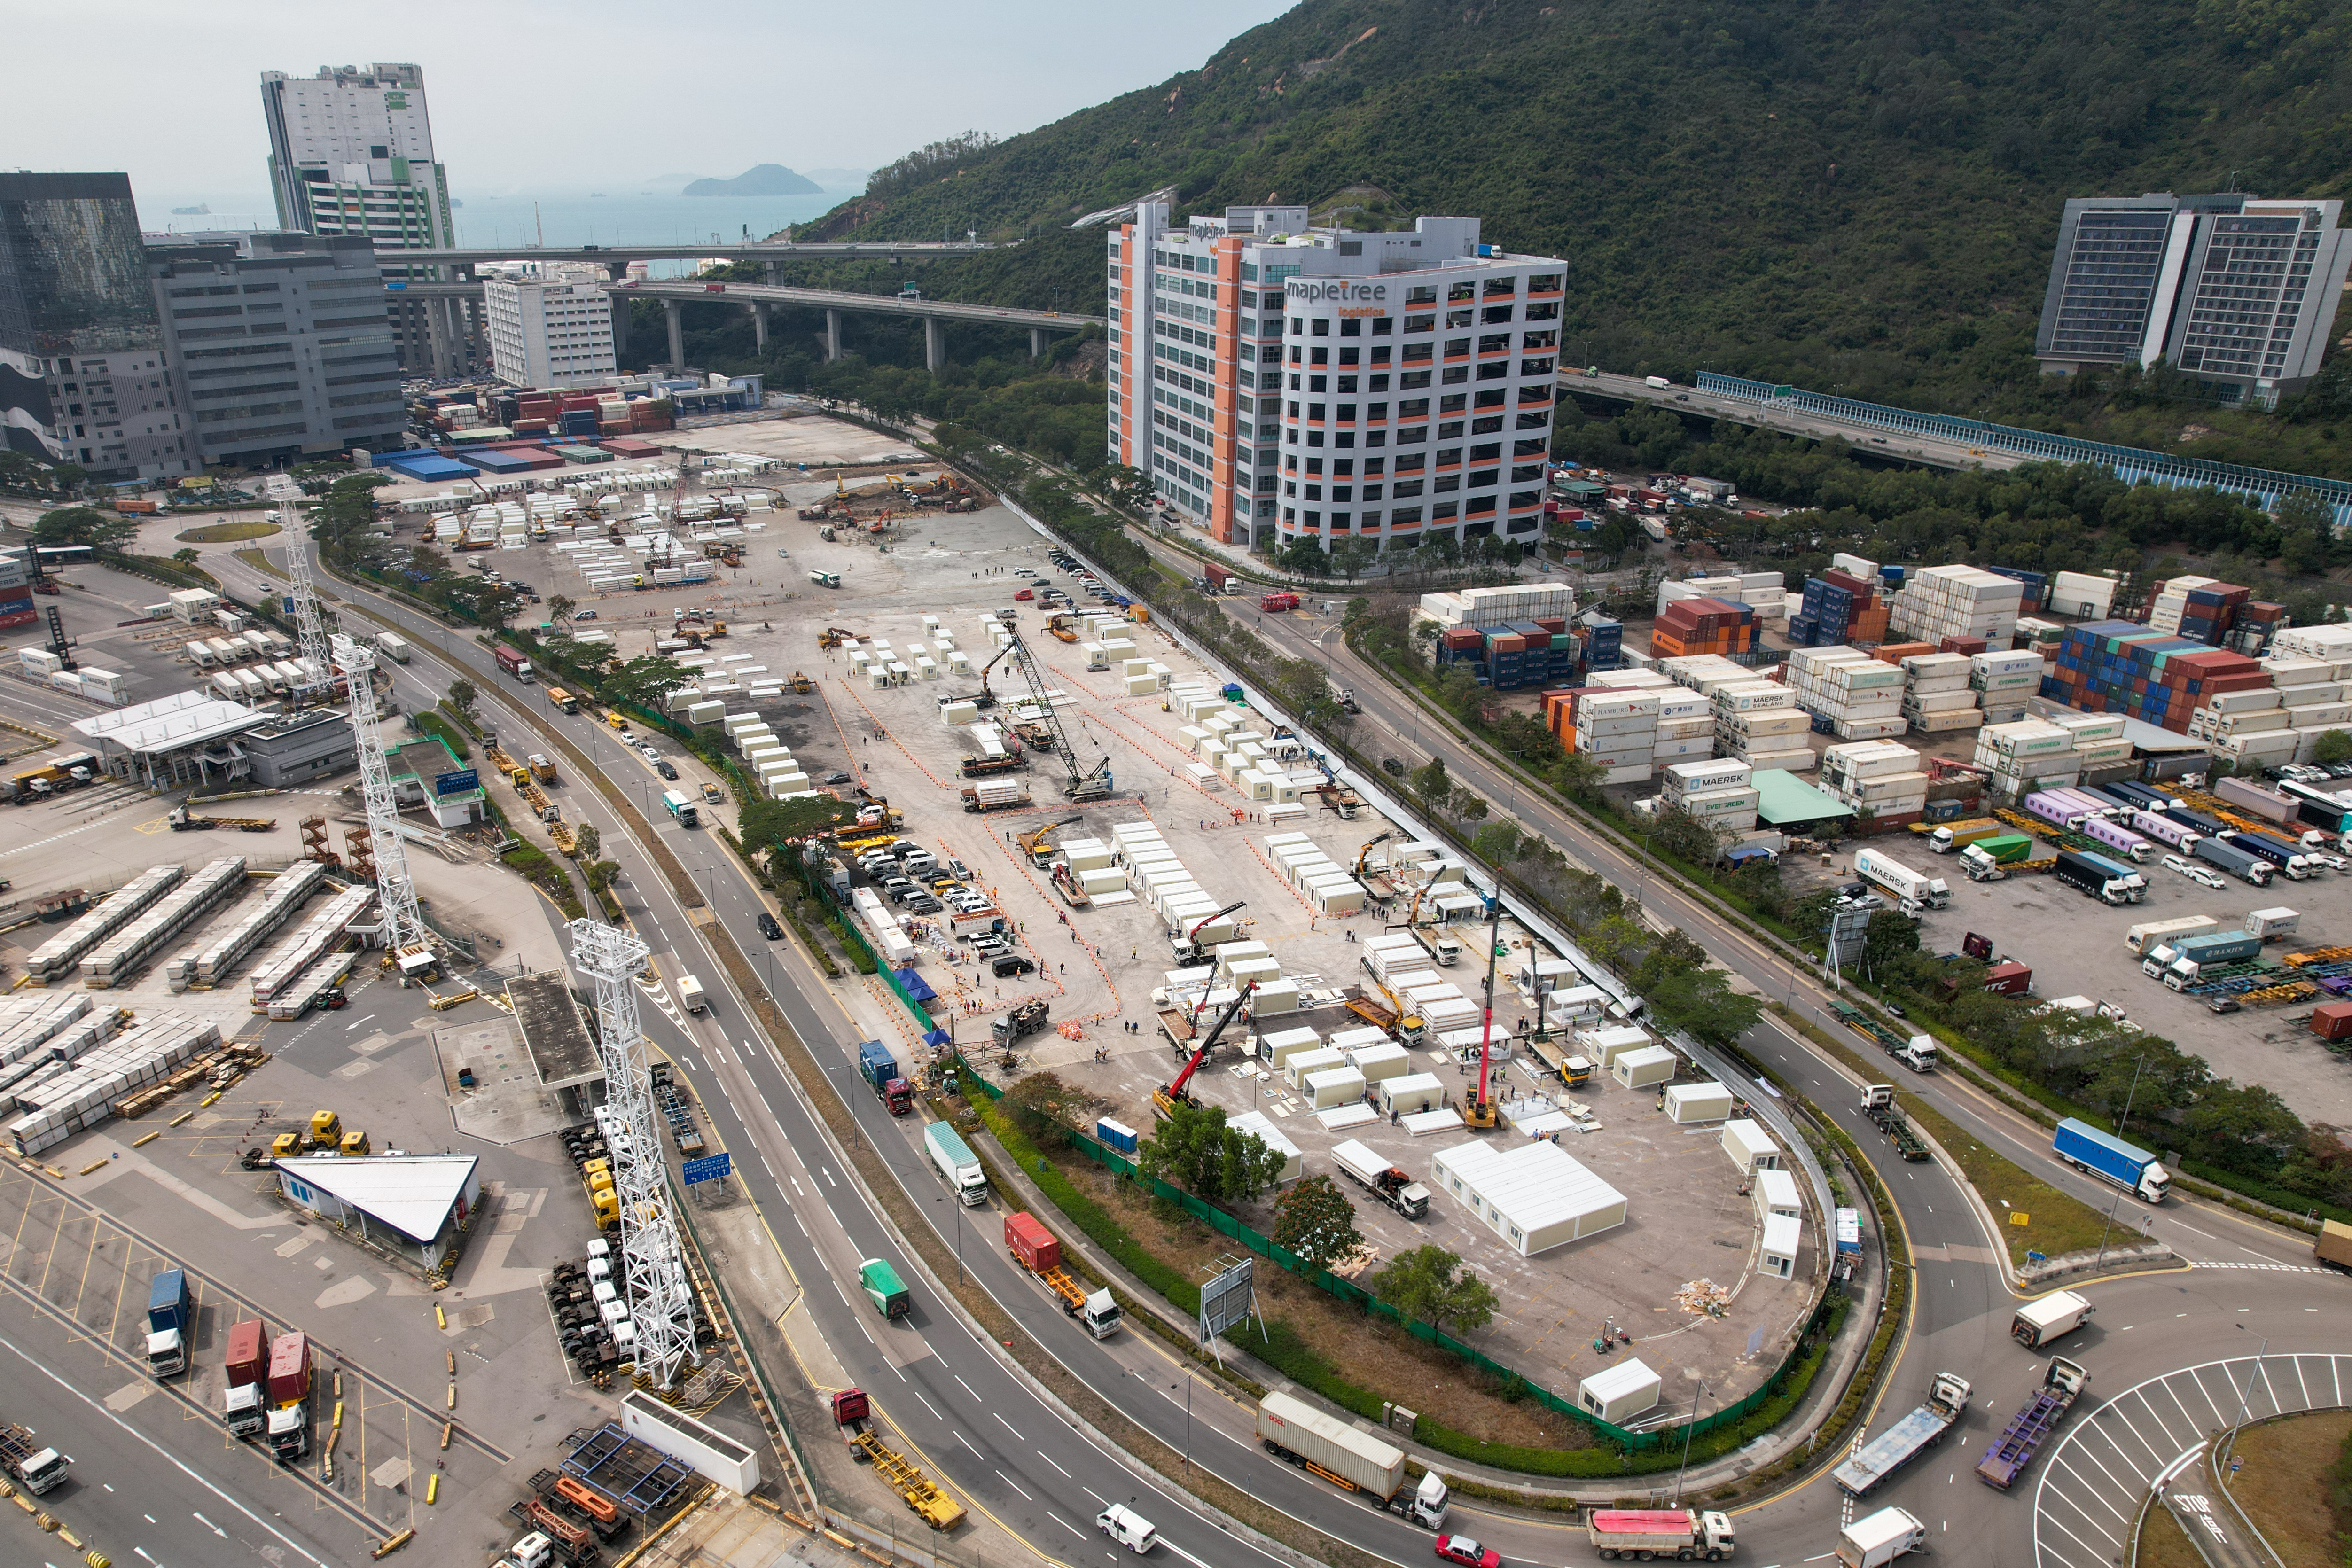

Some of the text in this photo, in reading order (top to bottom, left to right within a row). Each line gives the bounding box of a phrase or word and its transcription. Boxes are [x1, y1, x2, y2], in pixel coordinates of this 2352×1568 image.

[1190, 222, 1225, 242] mapletree
[1288, 281, 1386, 304] mapletree
[1338, 307, 1385, 320] logistics
[0, 577, 20, 586] ERSK
[27, 657, 46, 666] MAERSK
[31, 671, 49, 680] MAERSK
[59, 680, 78, 690] MAERSK
[87, 677, 108, 686] MAERSK
[1598, 706, 1629, 715] HAMBURG
[2079, 727, 2112, 736] EVERGREEN
[2027, 741, 2061, 750] EVERGREEN
[2087, 749, 2121, 759] EVERGREEN
[1702, 774, 1743, 787] MAERSK
[1870, 865, 1907, 890] MAERSK
[2214, 946, 2244, 956] HANJIN
[1979, 980, 2010, 992] ITC
[1013, 1235, 1030, 1256] K LINE
[1268, 1414, 1285, 1428] OOCL
[2173, 1494, 2211, 1513] STOP
[2199, 1514, 2228, 1544] 停
